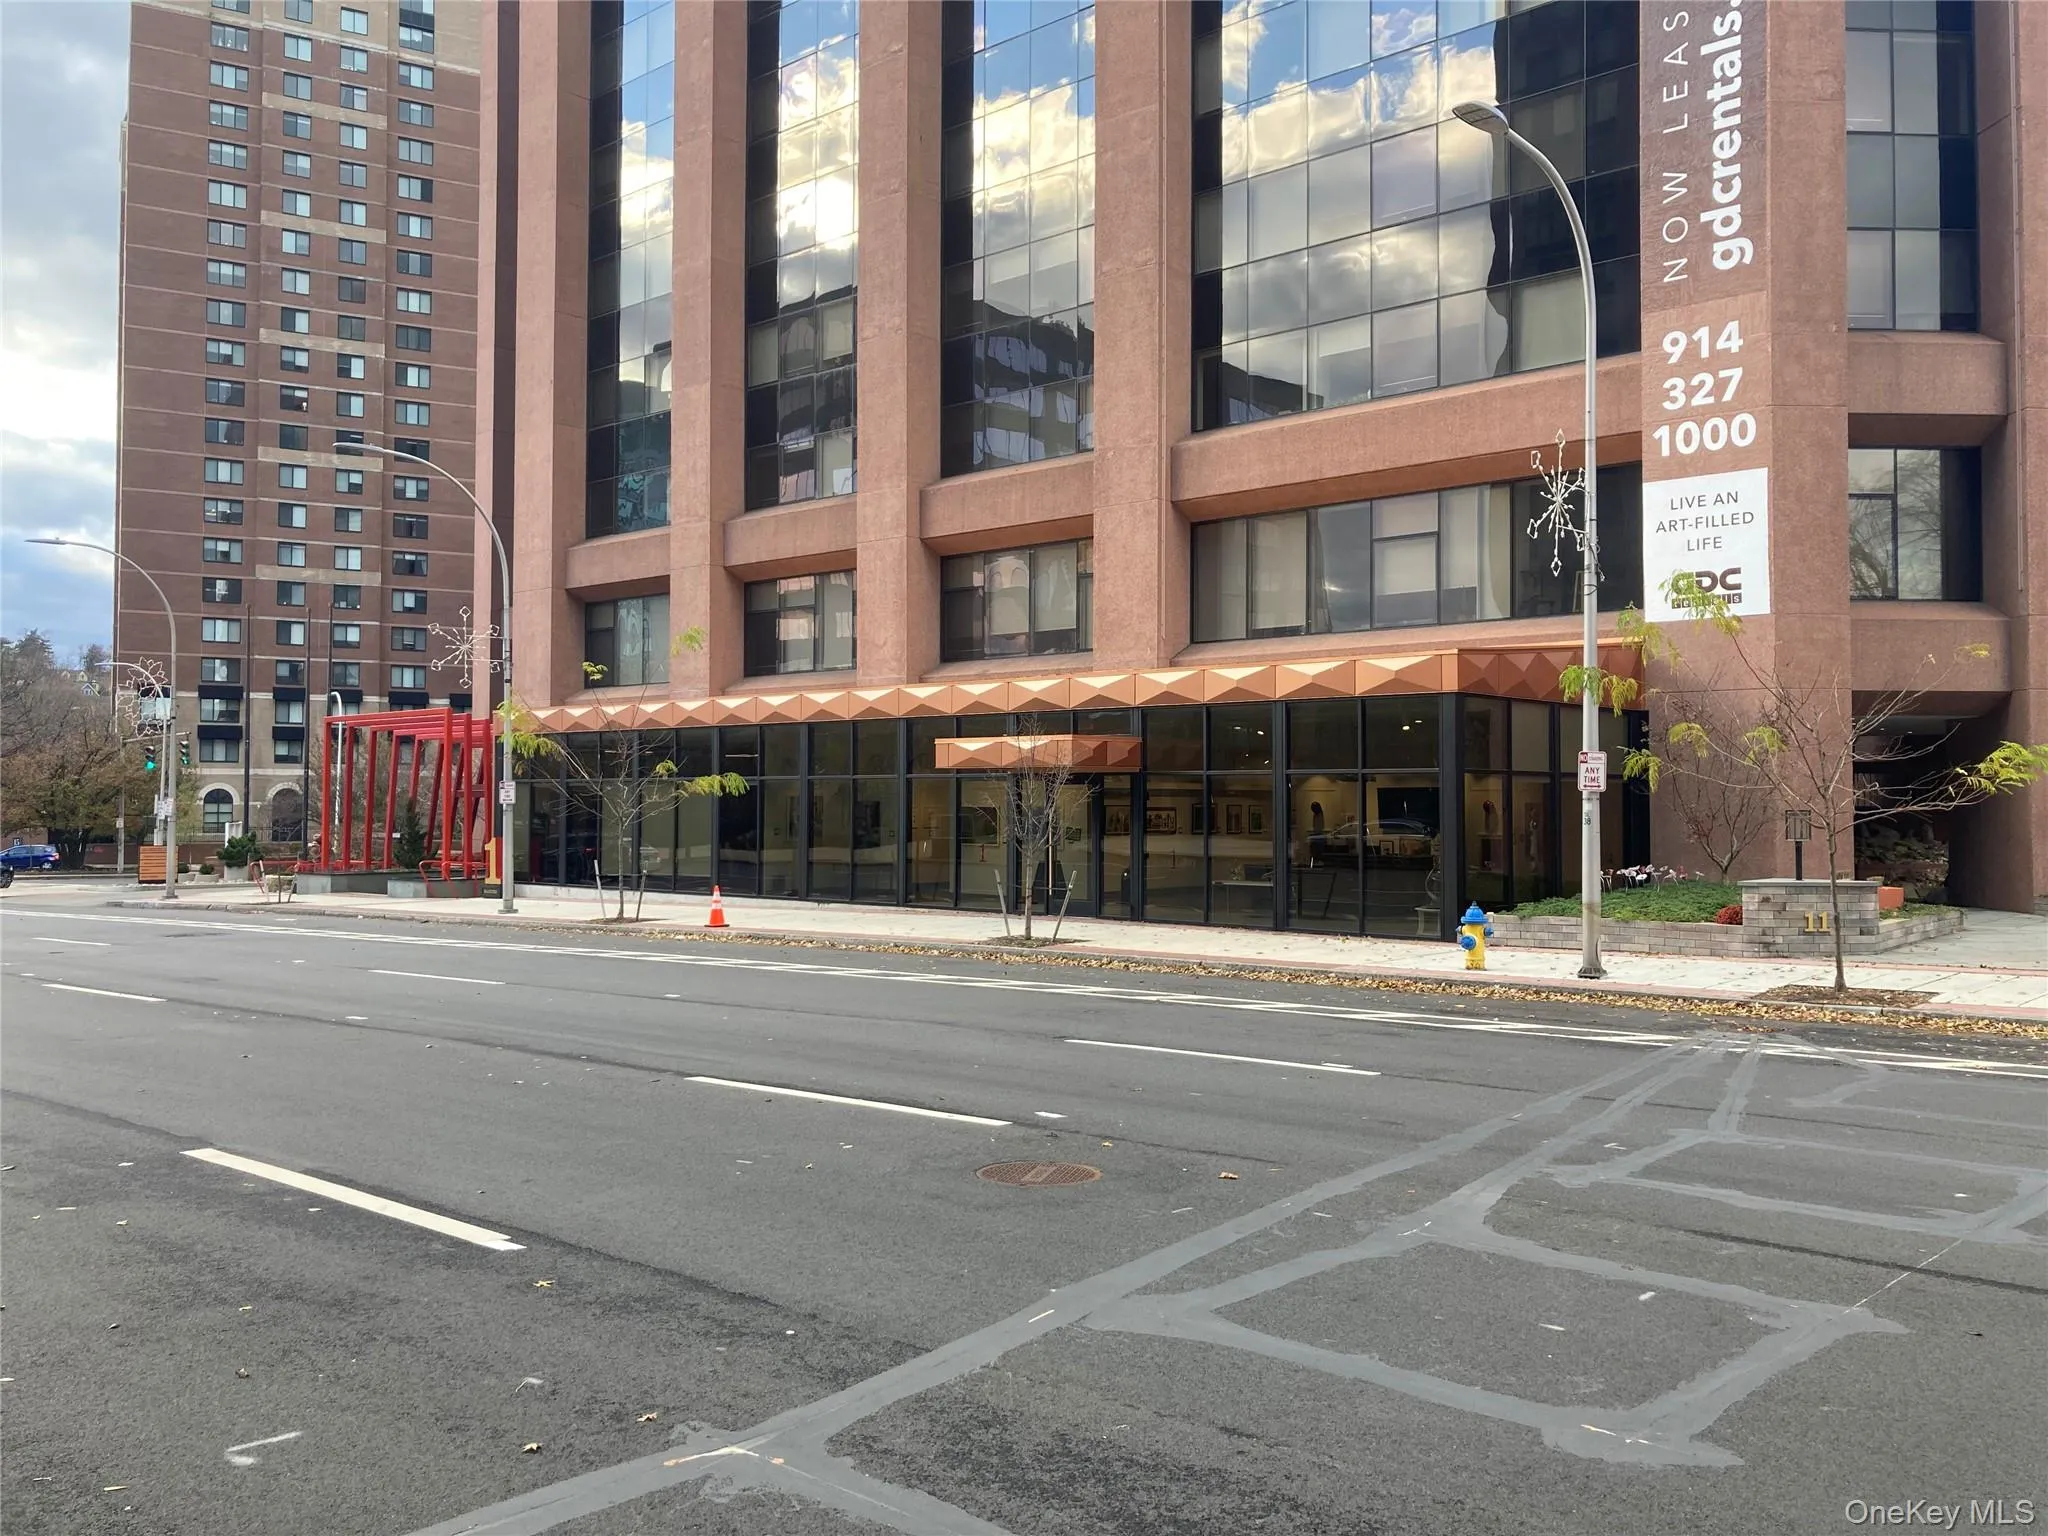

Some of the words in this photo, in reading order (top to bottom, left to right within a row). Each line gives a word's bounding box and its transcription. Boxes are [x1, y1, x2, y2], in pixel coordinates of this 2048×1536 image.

[1662, 11, 1689, 134] LEAS
[1662, 172, 1689, 283] NOW
[1662, 320, 1744, 365] 914
[1662, 367, 1743, 410] 327
[1652, 412, 1757, 457] 1000
[1670, 494, 1707, 511] LIVE
[1713, 491, 1739, 506] AN
[1655, 511, 1755, 534] ART-FILLED
[1687, 536, 1723, 552] LIFE
[1584, 776, 1601, 784] TIME
[1585, 766, 1600, 775] ANY
[1804, 911, 1832, 933] 11
